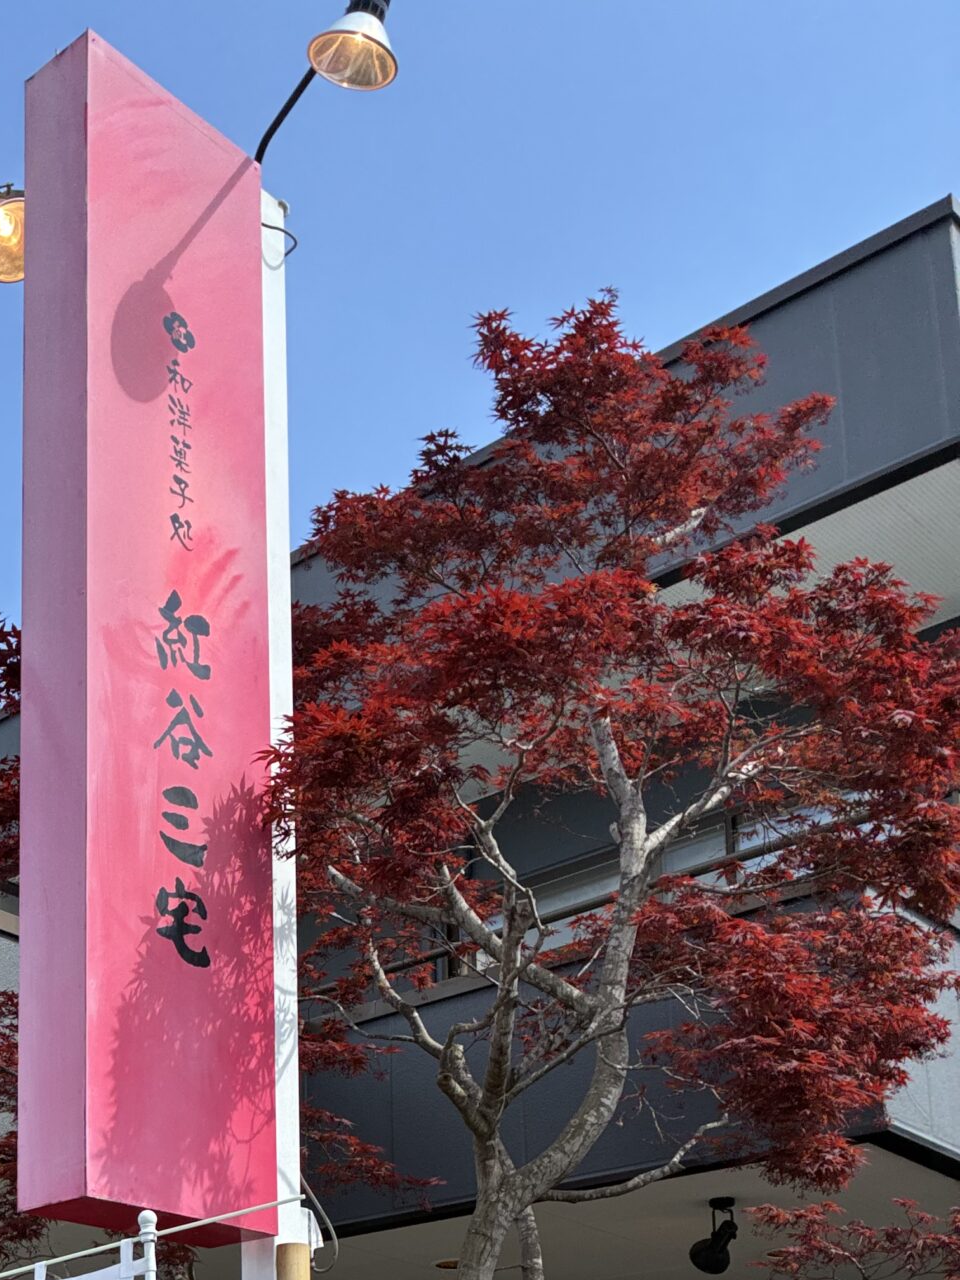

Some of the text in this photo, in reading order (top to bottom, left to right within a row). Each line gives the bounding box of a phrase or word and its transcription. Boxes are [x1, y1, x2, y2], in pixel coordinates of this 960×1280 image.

[153, 358, 213, 969] 和洋菓子処 紅谷三宅
